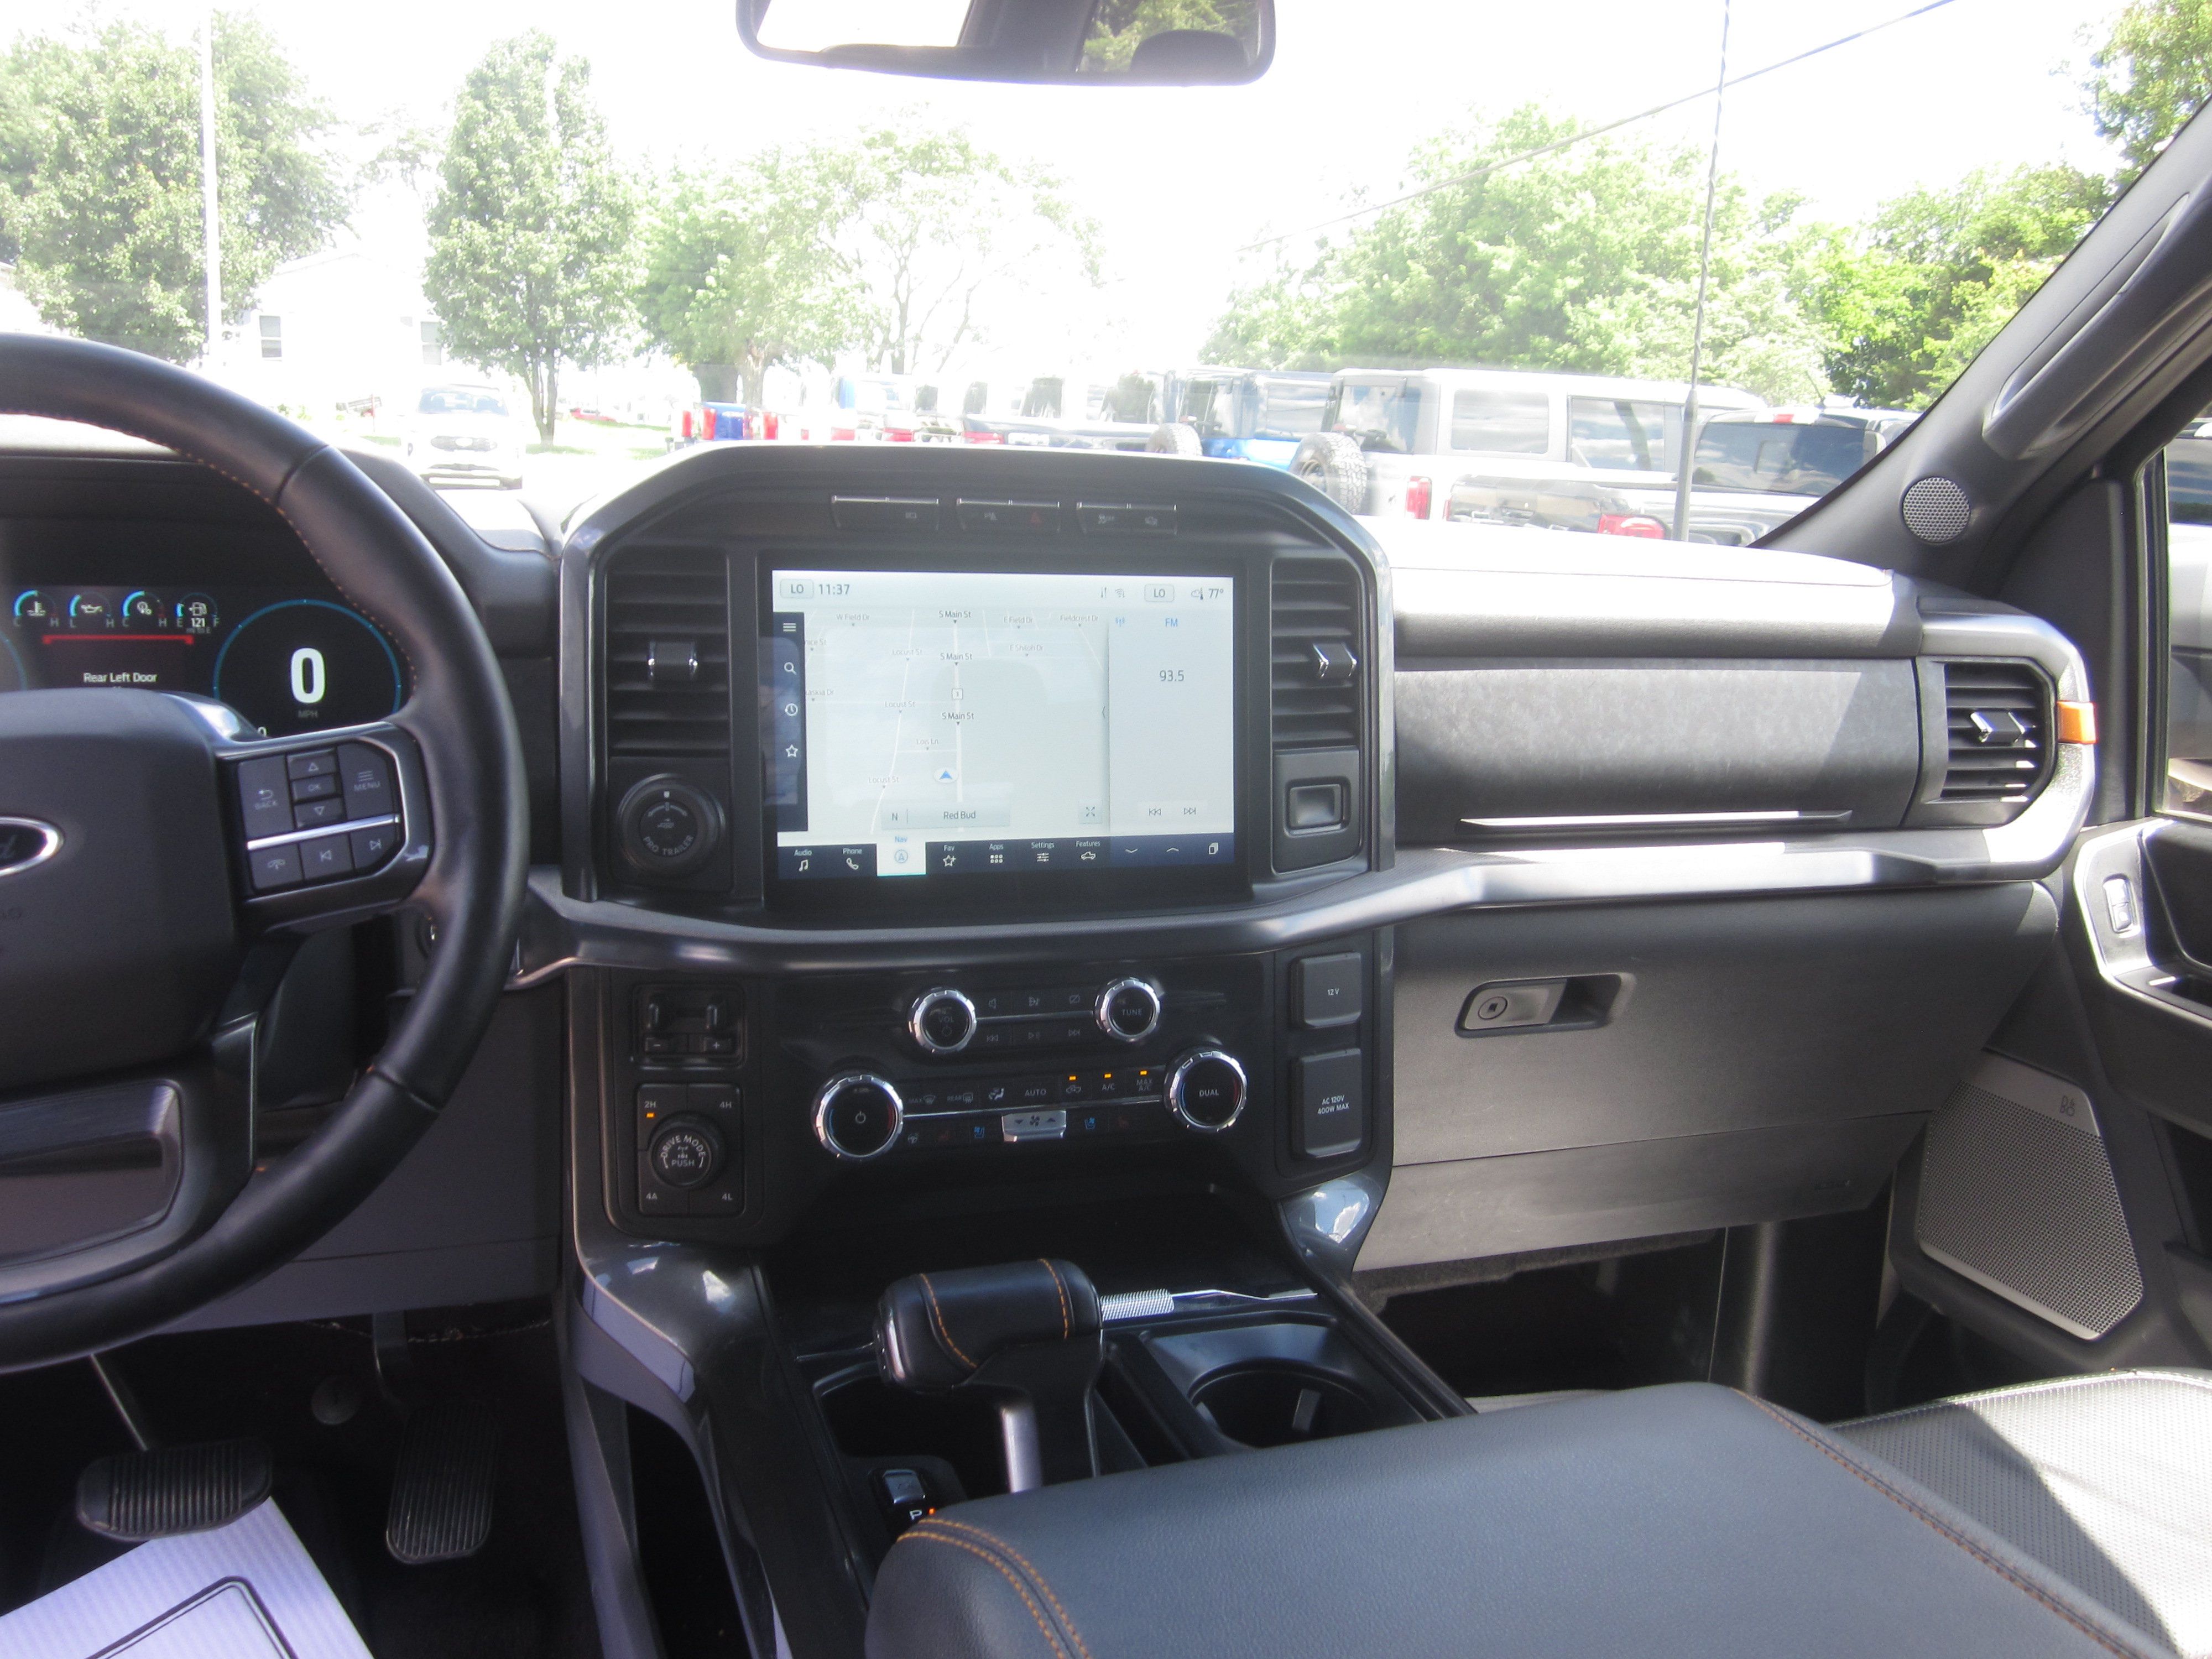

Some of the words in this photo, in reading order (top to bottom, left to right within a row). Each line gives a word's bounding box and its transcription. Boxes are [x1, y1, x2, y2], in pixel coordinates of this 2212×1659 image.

[790, 584, 804, 594] LO
[818, 584, 850, 594] 11:37
[1154, 588, 1166, 598] LO
[191, 617, 206, 628] 121
[1165, 618, 1178, 627] FM
[84, 673, 107, 682] Rear
[110, 673, 131, 682] Left
[133, 673, 158, 682] Door
[291, 648, 326, 703] 0
[1159, 670, 1185, 682] 93.5
[943, 811, 959, 820] Red
[961, 810, 976, 819] Bud
[989, 843, 1004, 851] Apps
[1031, 841, 1055, 850] Settings
[1121, 1008, 1143, 1016] TUNE
[1024, 1089, 1047, 1097] AUTO
[1331, 1095, 1345, 1104] 120V
[1317, 1105, 1335, 1114] 400W
[1336, 1103, 1349, 1111] MAX
[660, 1135, 682, 1159] DRIVE
[683, 1135, 706, 1157] MODE
[671, 1159, 695, 1167] PUSH
[909, 1510, 922, 1520] P
